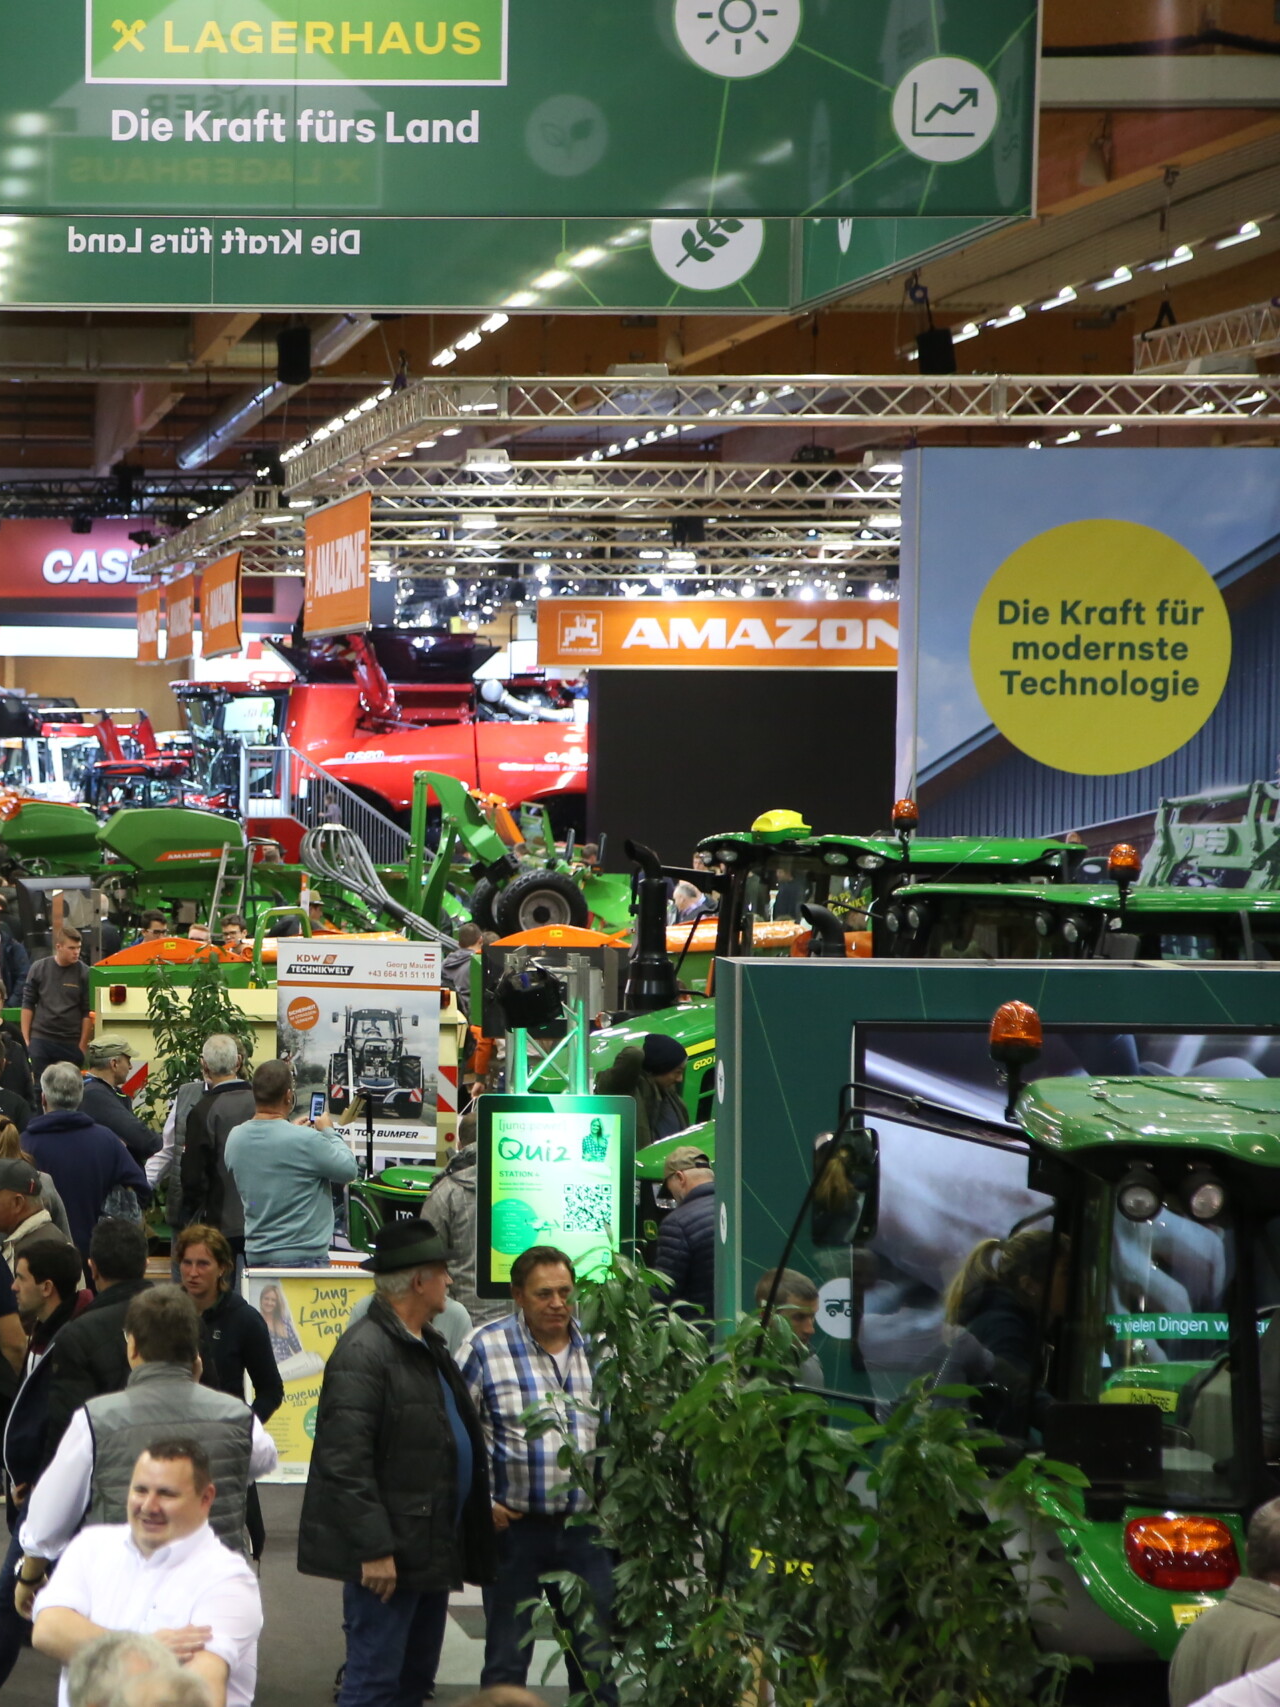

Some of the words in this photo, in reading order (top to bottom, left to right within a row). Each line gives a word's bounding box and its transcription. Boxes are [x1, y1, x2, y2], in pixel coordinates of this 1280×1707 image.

[164, 20, 482, 56] LAGERHAUS
[111, 108, 173, 142] Die
[184, 109, 286, 143] Kraft
[297, 109, 376, 143] fürs
[386, 110, 480, 143] Land
[998, 599, 1050, 626] Die
[1060, 598, 1146, 626] Kraft
[1156, 598, 1205, 626] für
[621, 617, 899, 650] AMAZON
[1012, 634, 1189, 661] modernste
[1000, 669, 1200, 703] Technologie
[291, 965, 350, 975] TECHNIKWELT
[296, 954, 321, 963] KDW
[386, 961, 408, 970] Georg
[409, 962, 435, 970] Mauser
[368, 970, 382, 978] +43
[693, 1055, 716, 1070] 6120
[498, 1136, 571, 1163] Quiz
[311, 1287, 355, 1307] Jung-
[1159, 1316, 1209, 1336] Dingen
